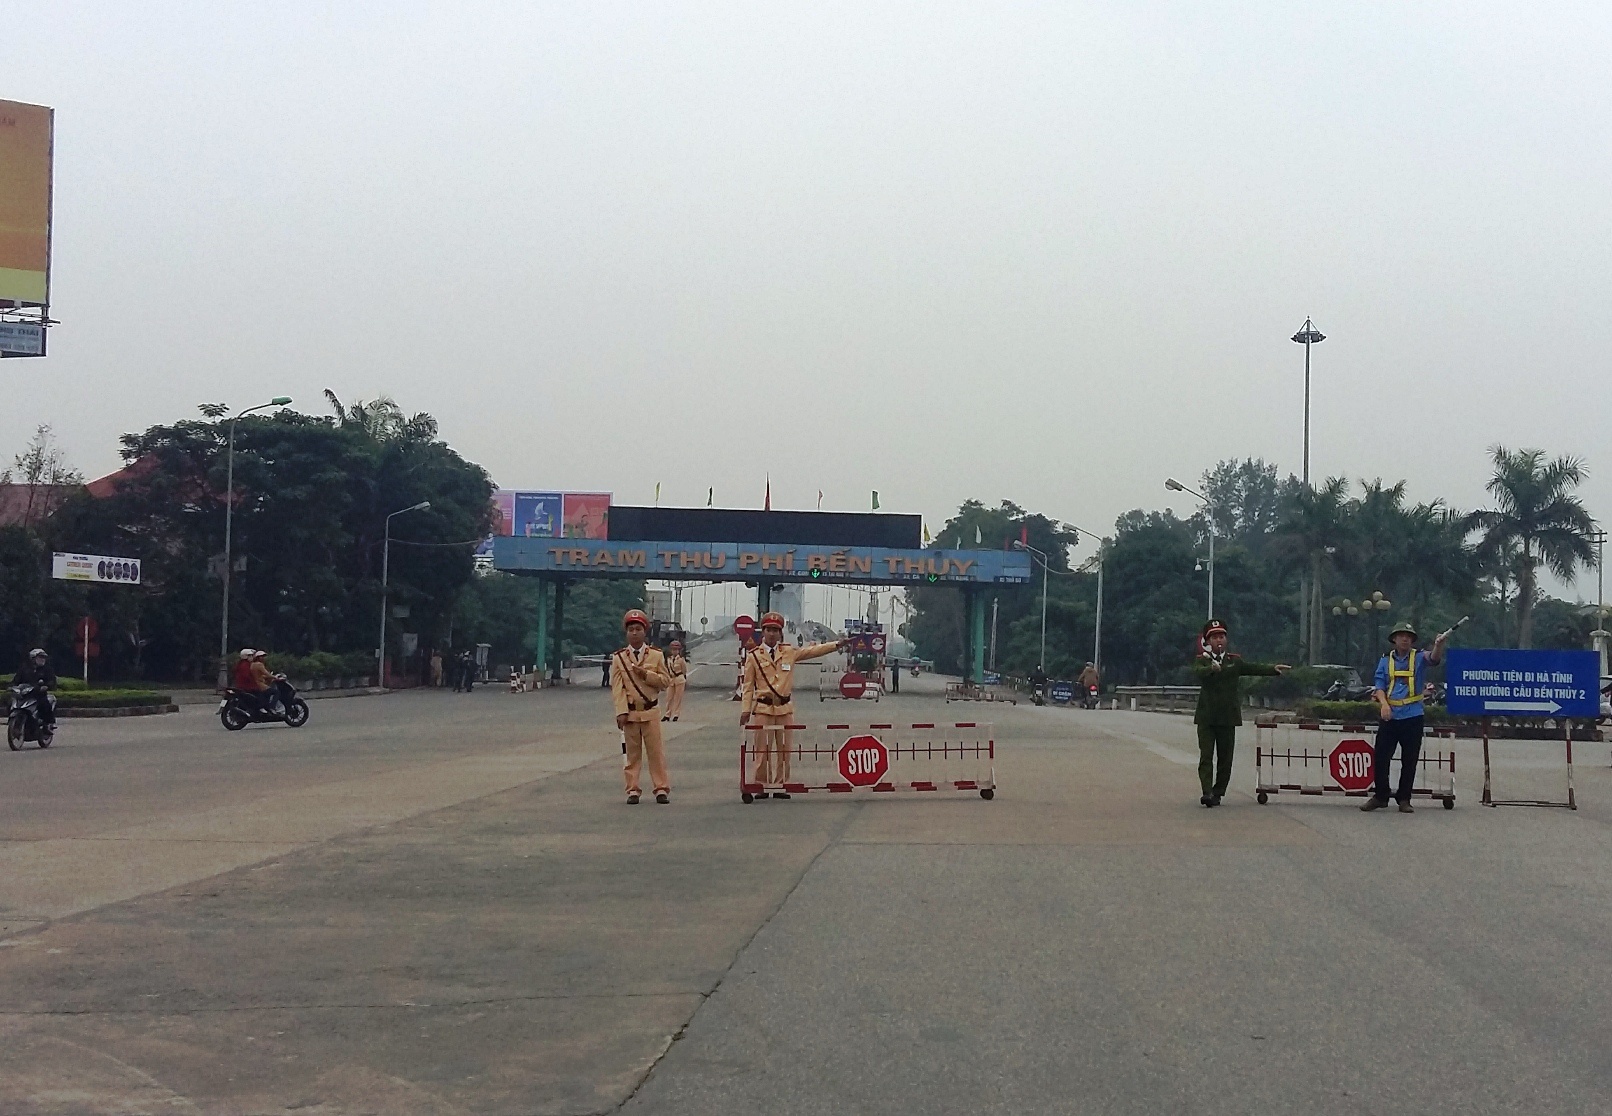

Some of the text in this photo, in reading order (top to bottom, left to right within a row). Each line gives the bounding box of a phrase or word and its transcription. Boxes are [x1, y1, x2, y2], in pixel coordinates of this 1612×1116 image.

[657, 551, 726, 570] THU
[738, 549, 797, 571] PHÍ
[806, 549, 872, 573] BẾN
[1462, 669, 1500, 681] PHƯƠNG
[1502, 669, 1523, 684] TIỆN
[1524, 671, 1535, 682] ĐI
[1536, 670, 1549, 683] HÀ
[1454, 685, 1477, 696] THEO
[1513, 683, 1532, 698] CẦU
[1533, 684, 1553, 699] BẾN
[1579, 689, 1586, 700] 2
[847, 747, 880, 776] STOP
[1338, 751, 1373, 779] STOP
